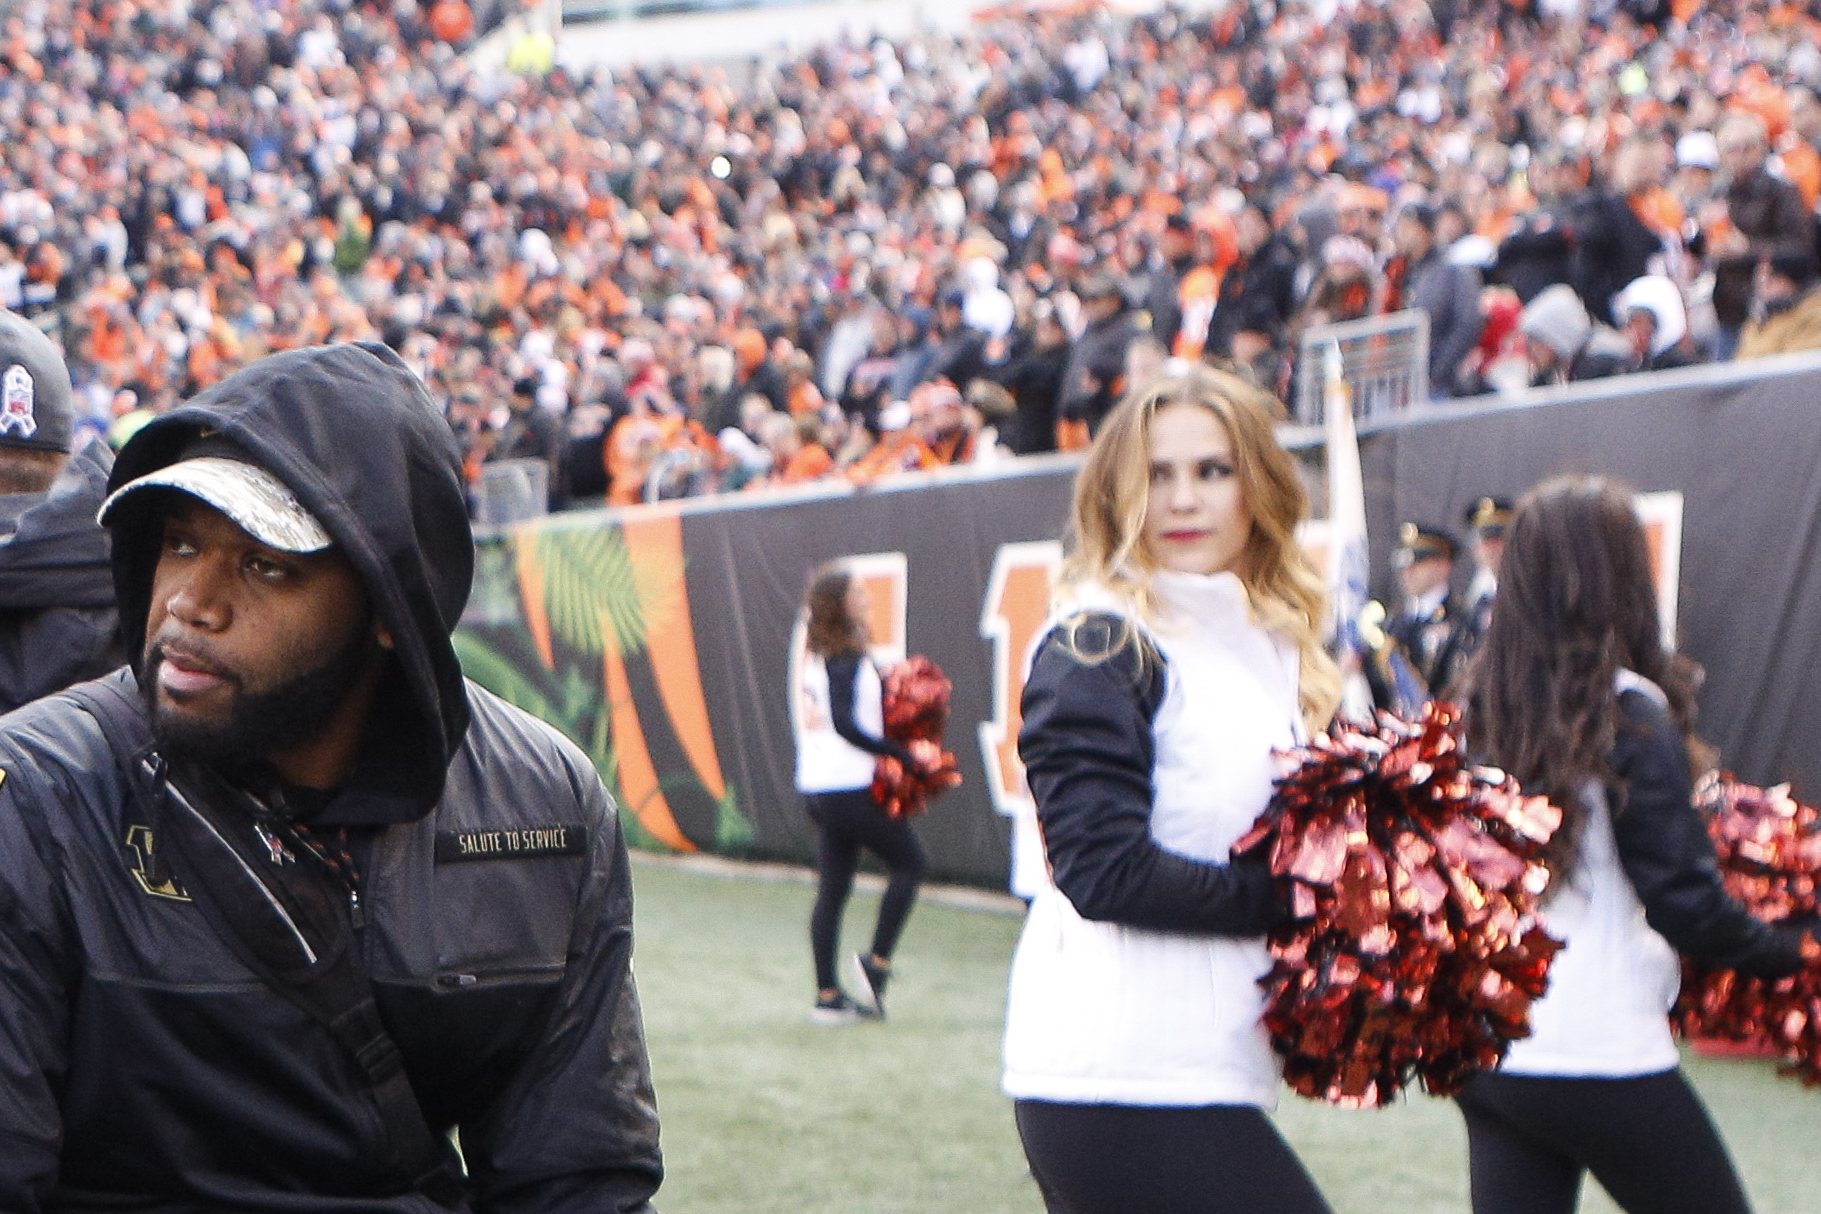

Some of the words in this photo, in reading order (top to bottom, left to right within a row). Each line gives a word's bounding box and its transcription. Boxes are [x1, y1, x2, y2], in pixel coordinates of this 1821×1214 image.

[458, 832, 502, 854] SALUTE
[504, 831, 520, 851] TO
[522, 828, 567, 850] SERVICE
